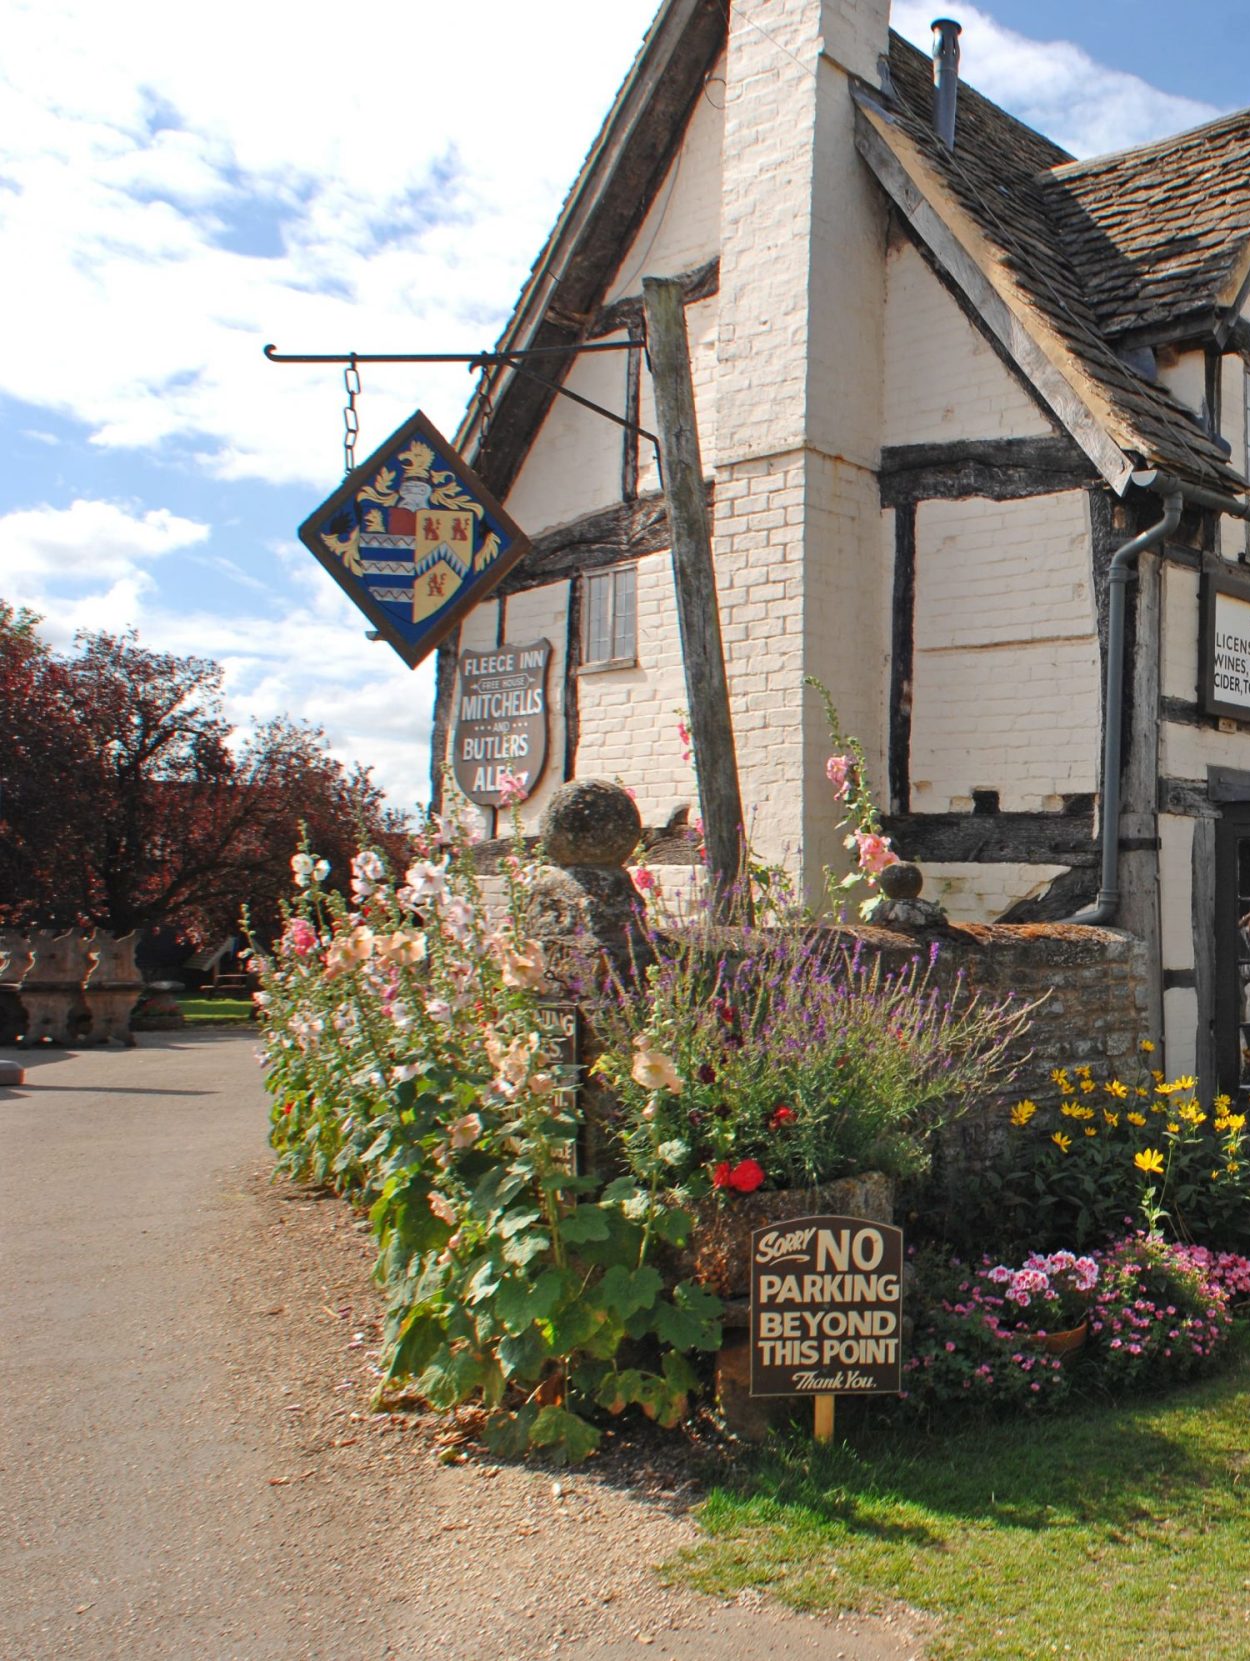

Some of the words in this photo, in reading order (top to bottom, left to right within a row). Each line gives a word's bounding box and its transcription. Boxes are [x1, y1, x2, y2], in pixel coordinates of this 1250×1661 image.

[464, 654, 514, 676] FLEECE
[520, 650, 544, 668] INN
[1214, 653, 1249, 676] WINES,
[482, 680, 499, 690] FREE
[502, 677, 525, 688] HOUSE
[461, 688, 543, 720] MITCHELLS
[492, 721, 510, 732] AND
[463, 734, 529, 760] BUTLERS
[472, 766, 517, 791] ALE
[816, 1228, 884, 1272] NO
[759, 1274, 900, 1303] PARKING
[759, 1311, 897, 1338] BEYOND
[758, 1340, 820, 1366] THIS
[822, 1338, 899, 1365] POINT
[792, 1371, 844, 1390] Thank
[843, 1371, 877, 1389] You.
